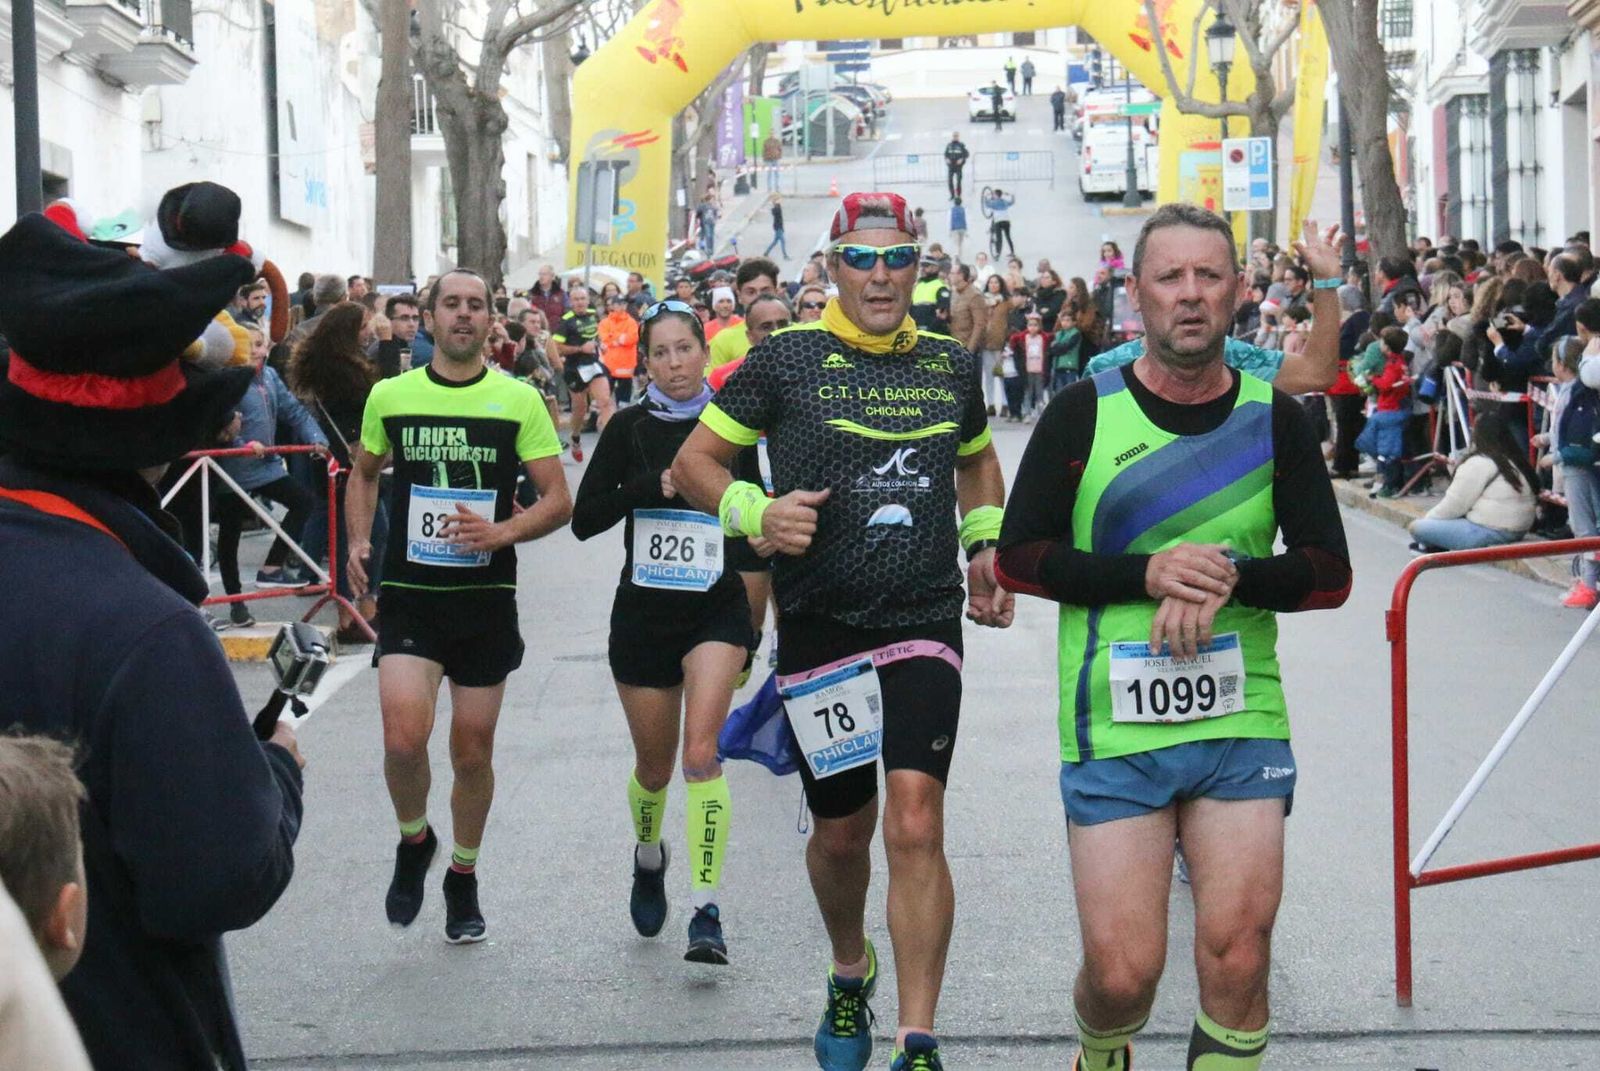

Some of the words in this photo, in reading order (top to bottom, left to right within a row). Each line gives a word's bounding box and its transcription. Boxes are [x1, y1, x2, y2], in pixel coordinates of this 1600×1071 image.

[577, 250, 657, 268] DLEGACION
[818, 386, 853, 399] C.T.
[858, 387, 880, 400] LA
[884, 387, 957, 404] BARROSA
[865, 406, 922, 417] CHICLANA
[402, 427, 415, 446] II
[419, 427, 467, 447] RUTA
[422, 512, 461, 539] 82
[409, 541, 490, 564] CHICLA
[649, 533, 695, 562] 826
[635, 565, 717, 588] CHICLANA
[1127, 674, 1216, 716] 1099
[814, 702, 855, 739] 78
